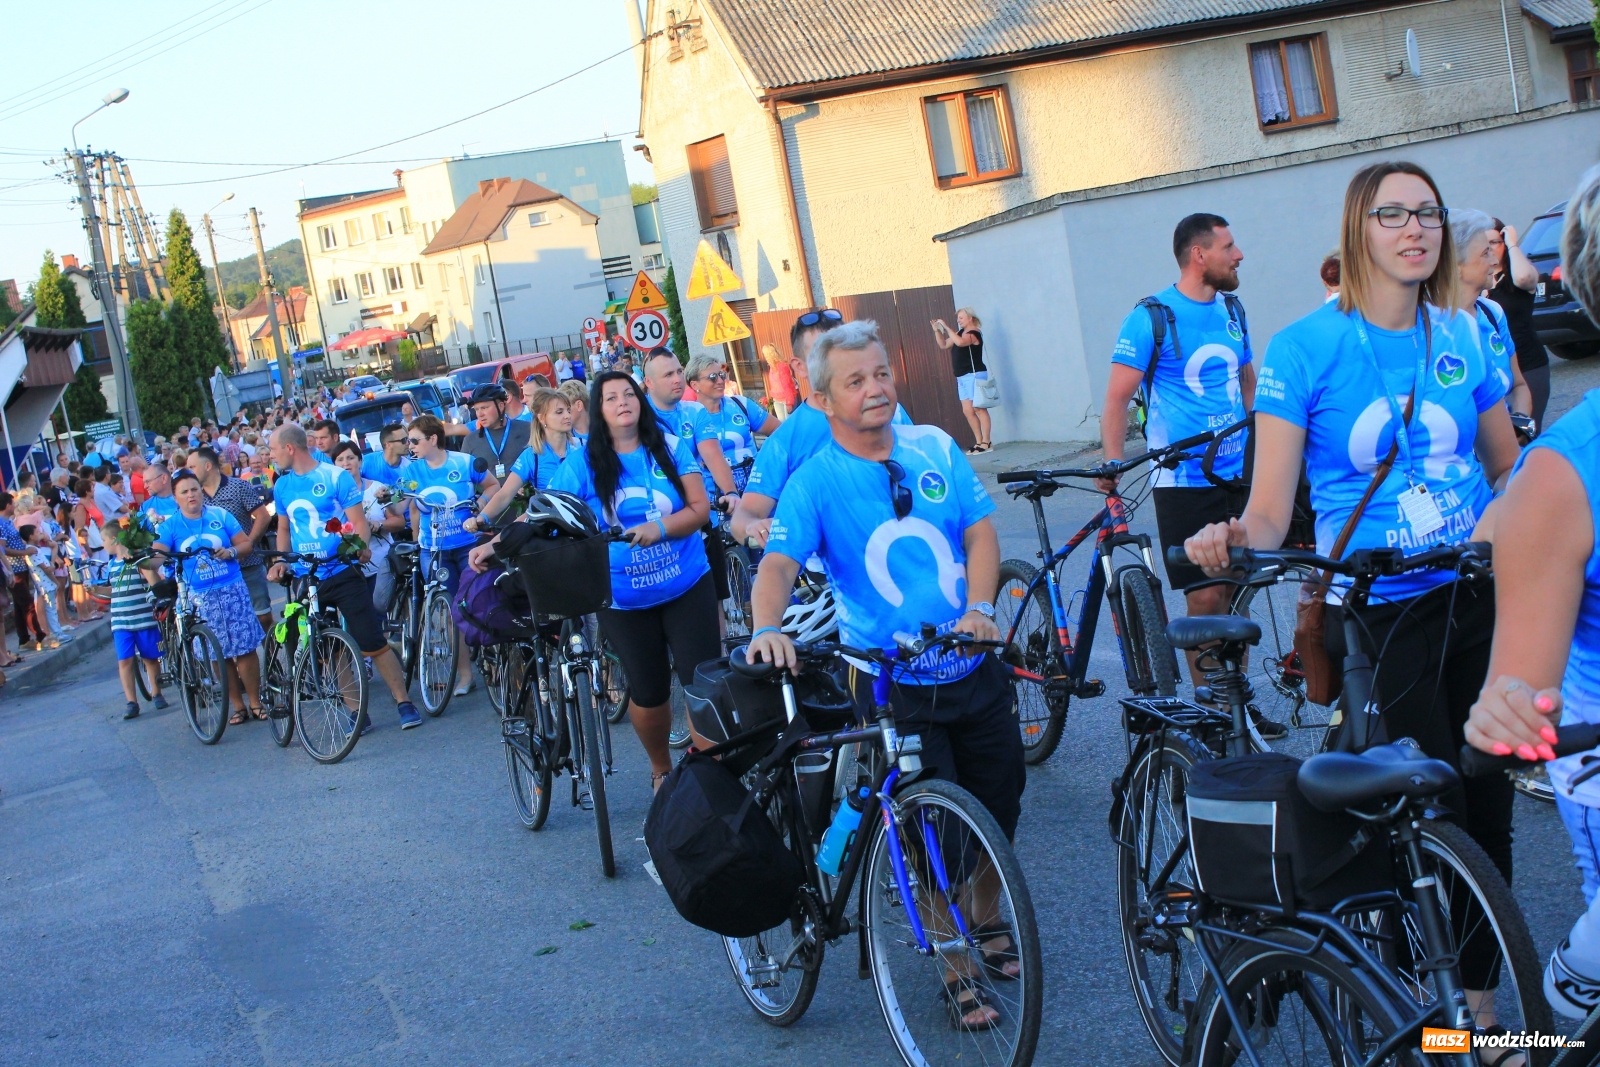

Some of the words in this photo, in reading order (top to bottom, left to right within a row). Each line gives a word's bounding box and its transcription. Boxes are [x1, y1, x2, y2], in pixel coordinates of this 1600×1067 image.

[633, 319, 663, 342] 30
[1396, 488, 1461, 523] JEM
[630, 541, 672, 564] JESTEM
[631, 563, 681, 589] CZUWAM
